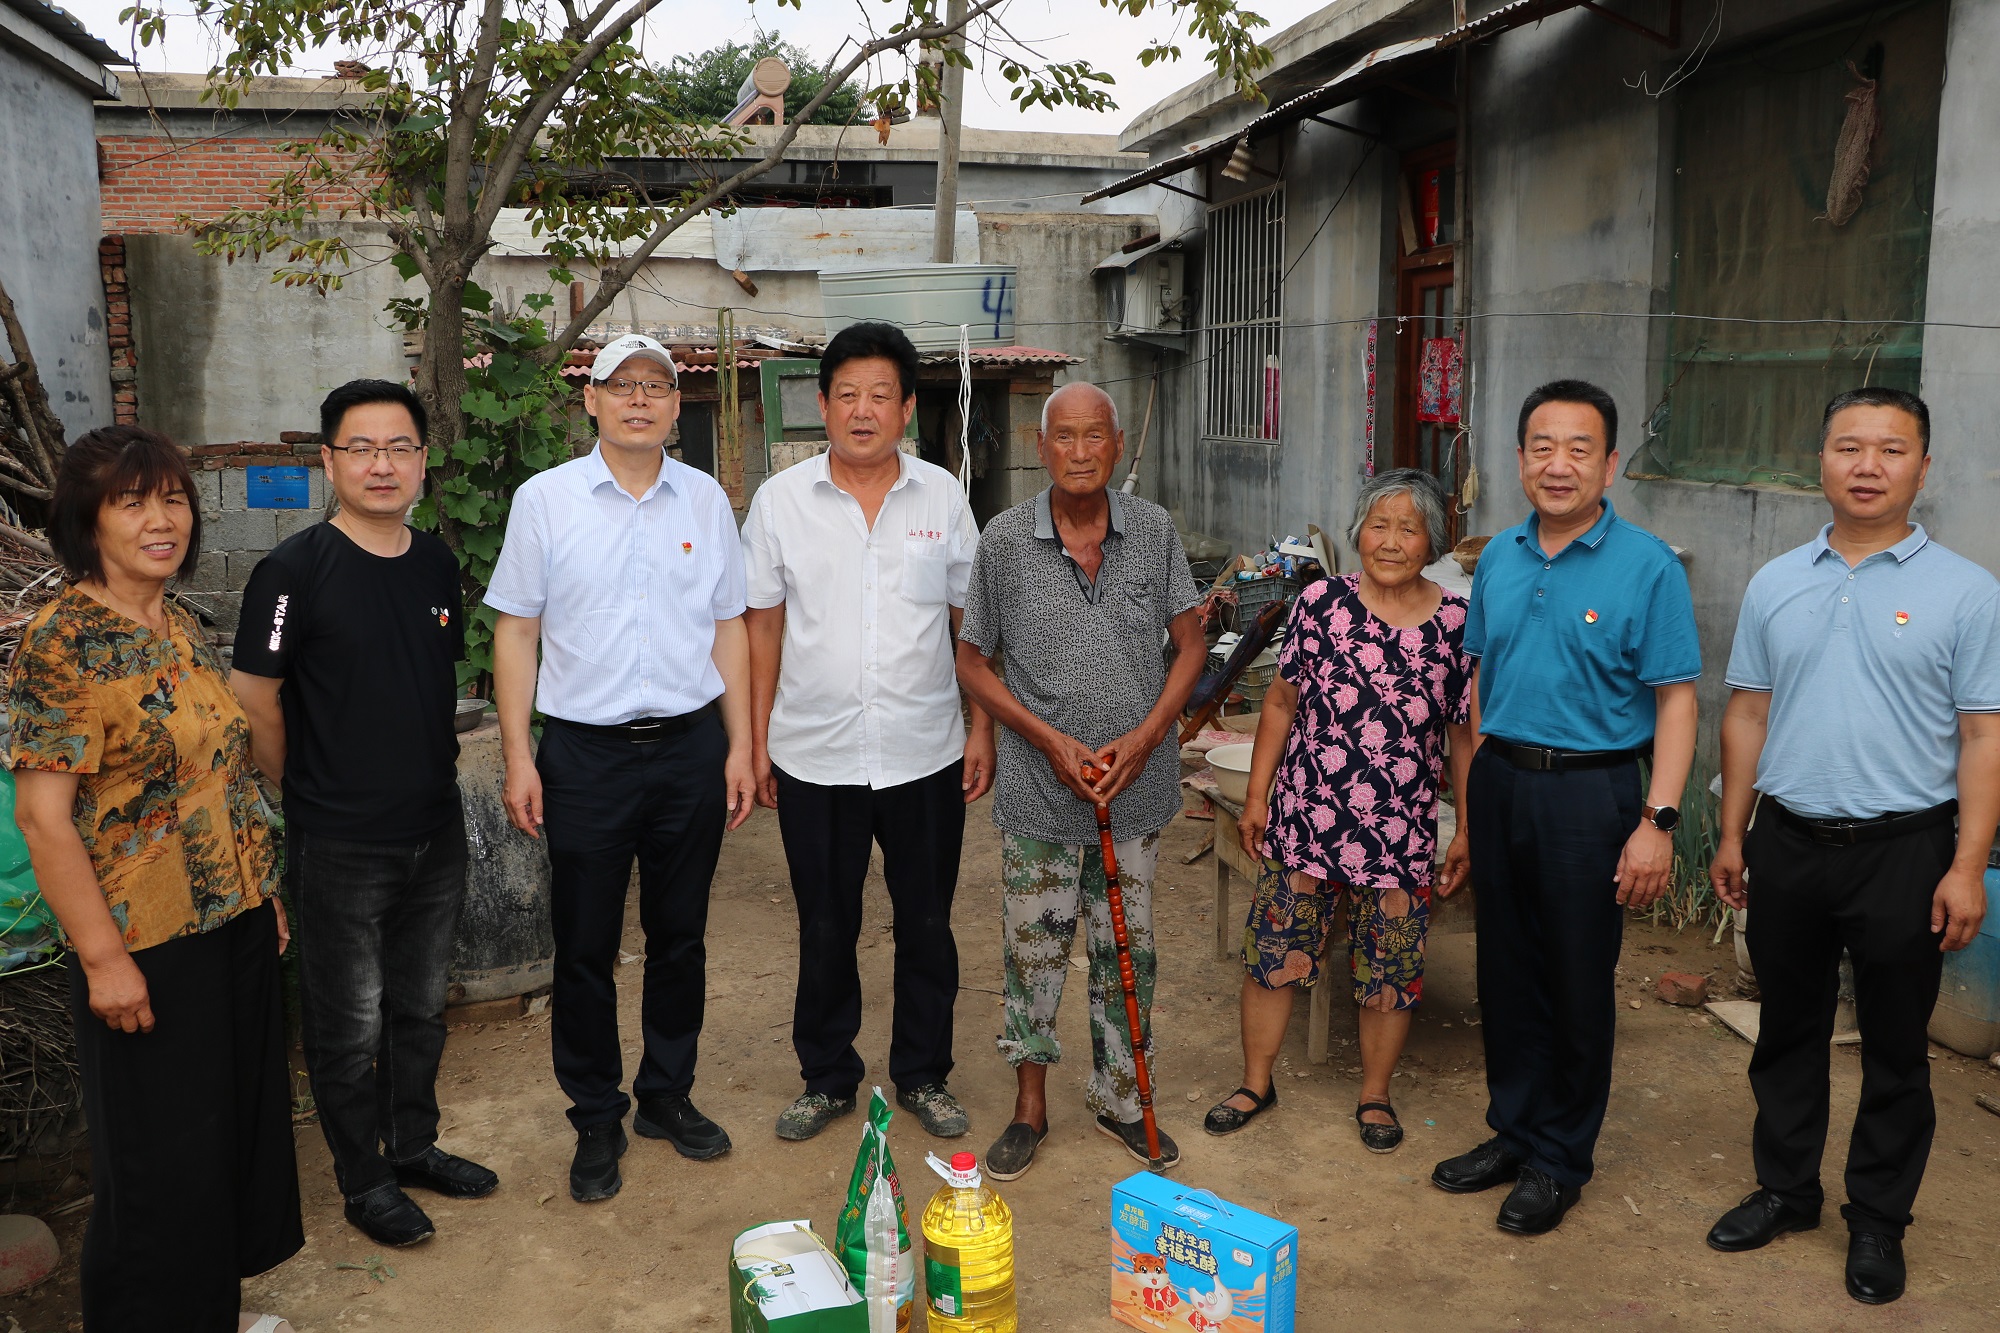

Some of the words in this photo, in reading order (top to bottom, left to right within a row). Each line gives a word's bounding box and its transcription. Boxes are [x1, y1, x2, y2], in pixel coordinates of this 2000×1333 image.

[982, 276, 1012, 339] 4
[1156, 1236, 1217, 1275] 幸福发酵
